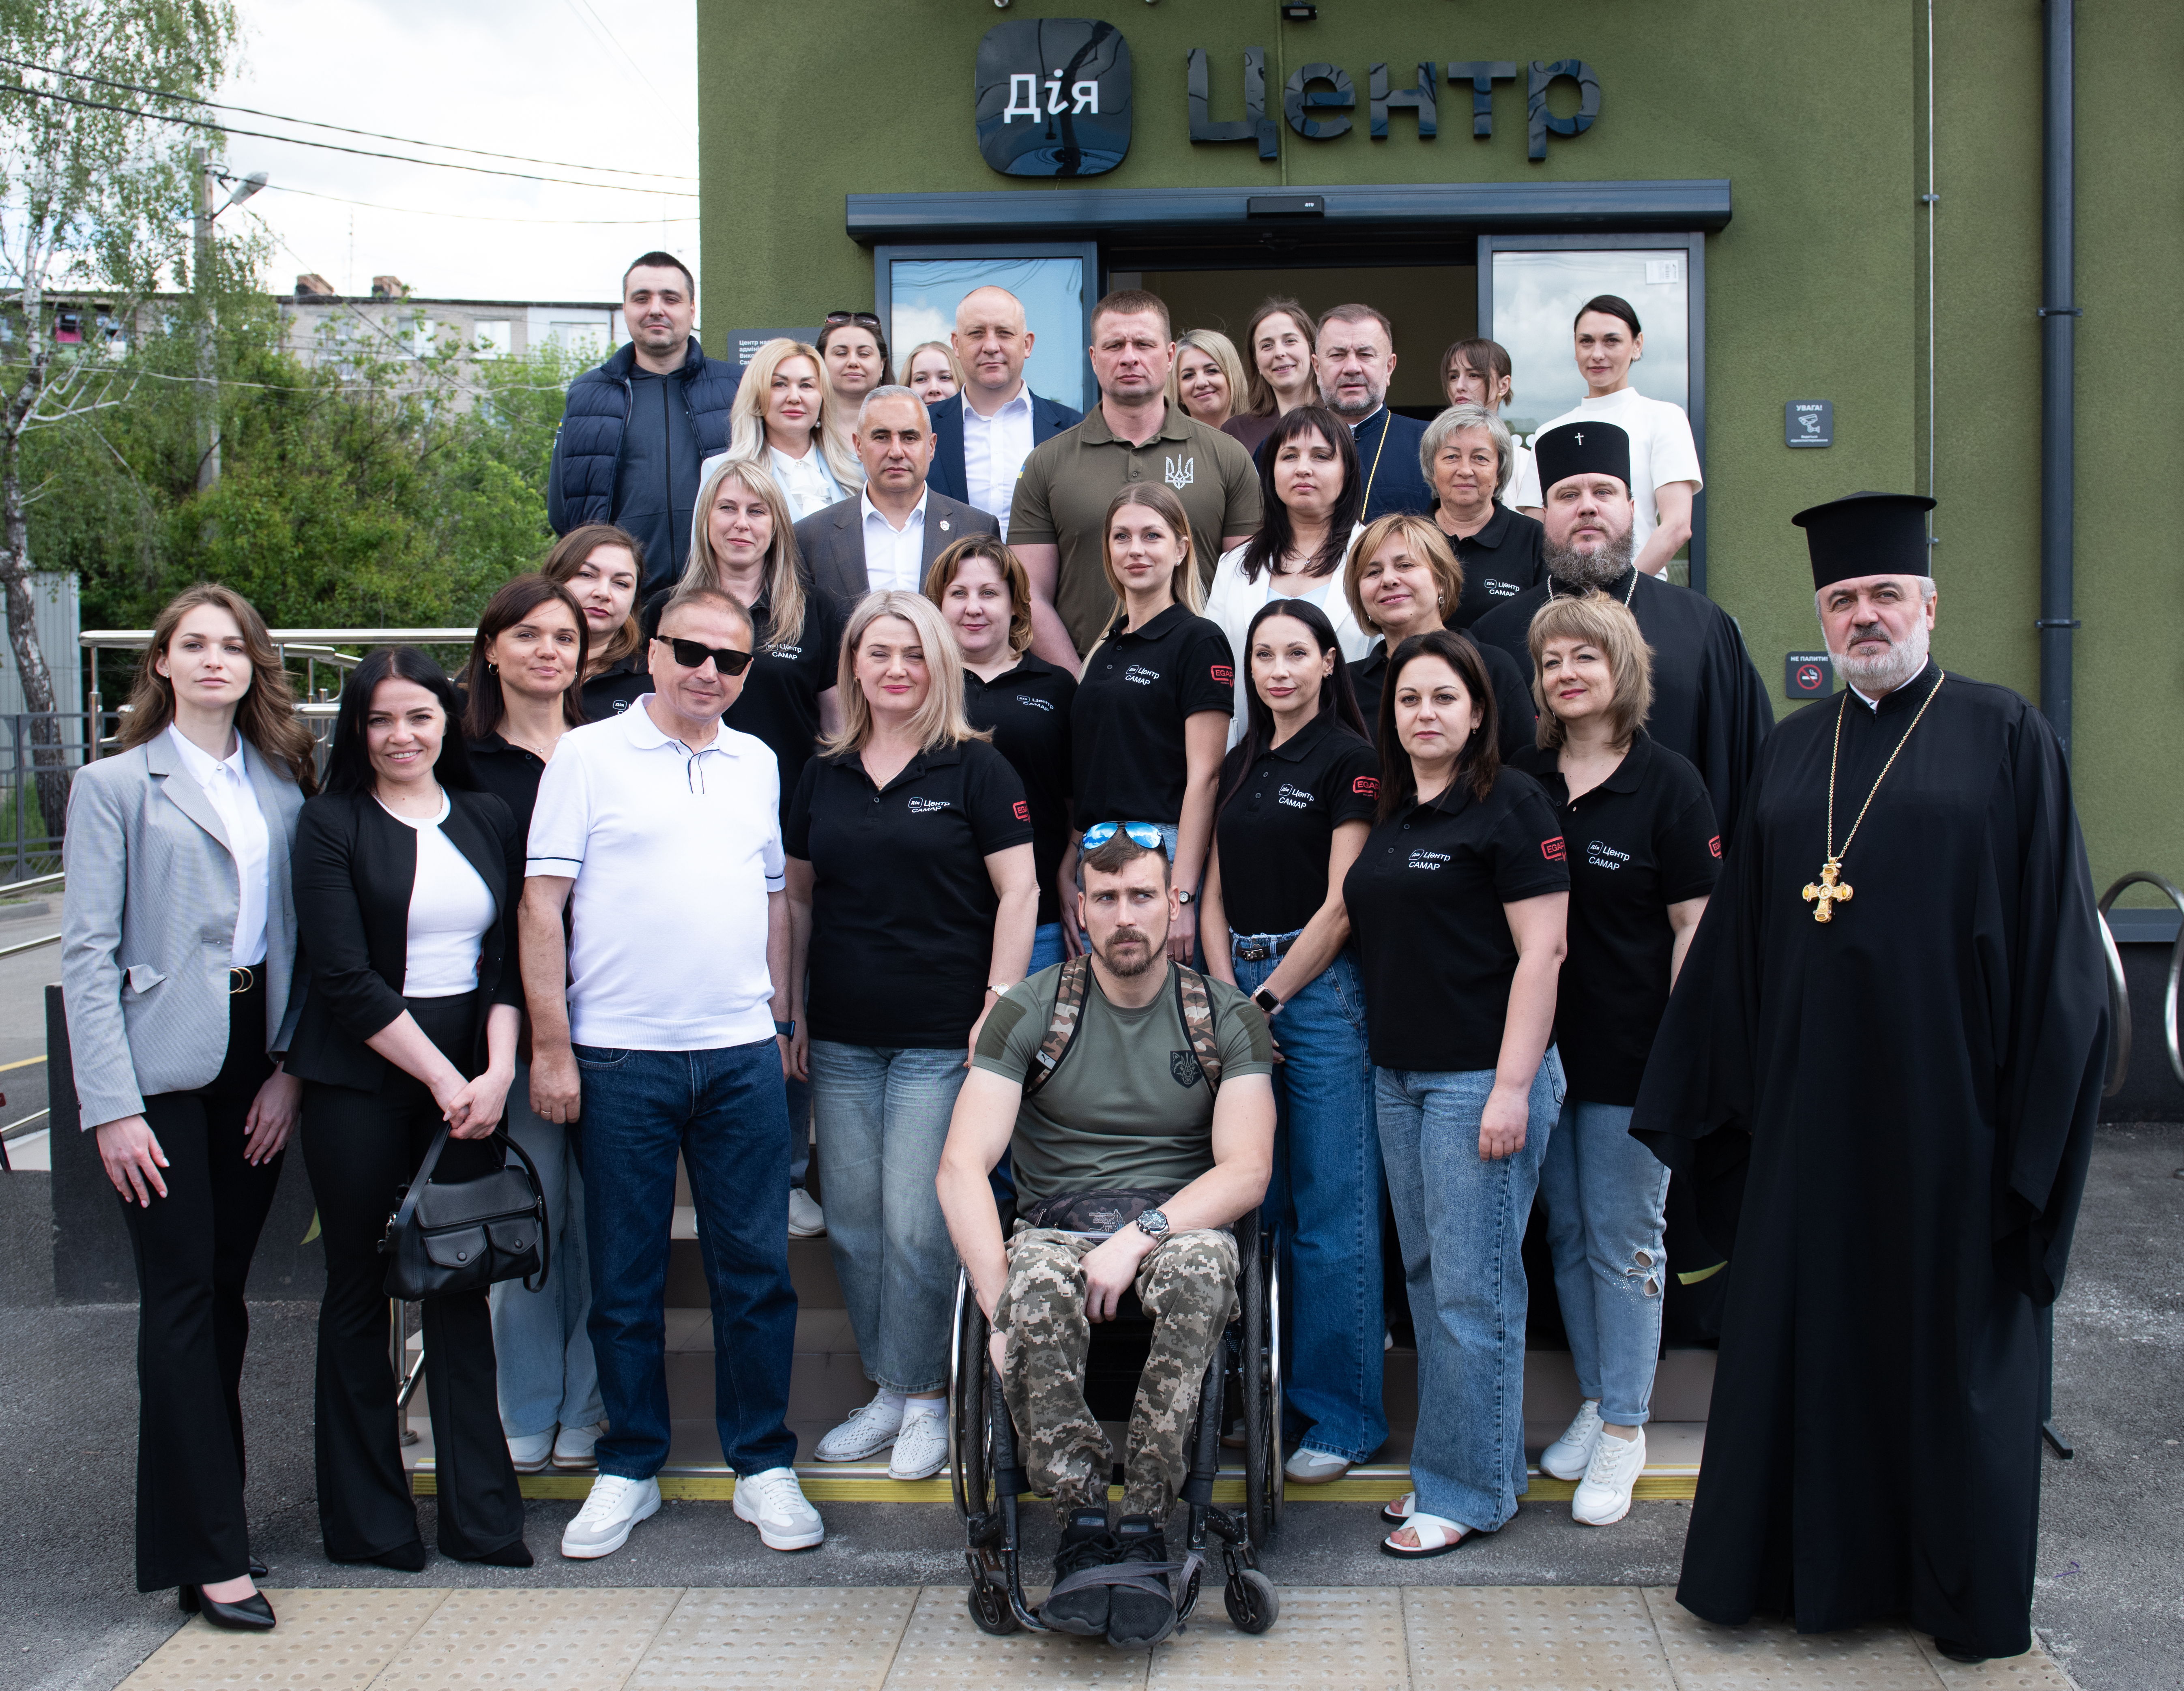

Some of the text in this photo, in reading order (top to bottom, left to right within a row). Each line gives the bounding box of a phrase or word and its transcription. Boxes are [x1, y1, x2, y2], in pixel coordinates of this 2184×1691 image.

[1003, 46, 1601, 162] Дія Центр
[1498, 582, 1520, 592] Центр
[780, 644, 802, 653] Центр
[772, 652, 797, 660] САМАР
[1138, 667, 1159, 679] Центр
[1125, 675, 1150, 685] САМАР
[1023, 702, 1049, 711] САМАР
[1032, 698, 1054, 710] Центр
[1357, 781, 1379, 790] EGAP
[1292, 789, 1314, 801] Центр
[1279, 797, 1307, 809] САМАР
[1546, 842, 1564, 853] EGAP
[1423, 852, 1450, 862] Центр
[1603, 846, 1630, 861] Центр
[1409, 861, 1440, 870] САМАР
[1589, 856, 1620, 870] САМАР
